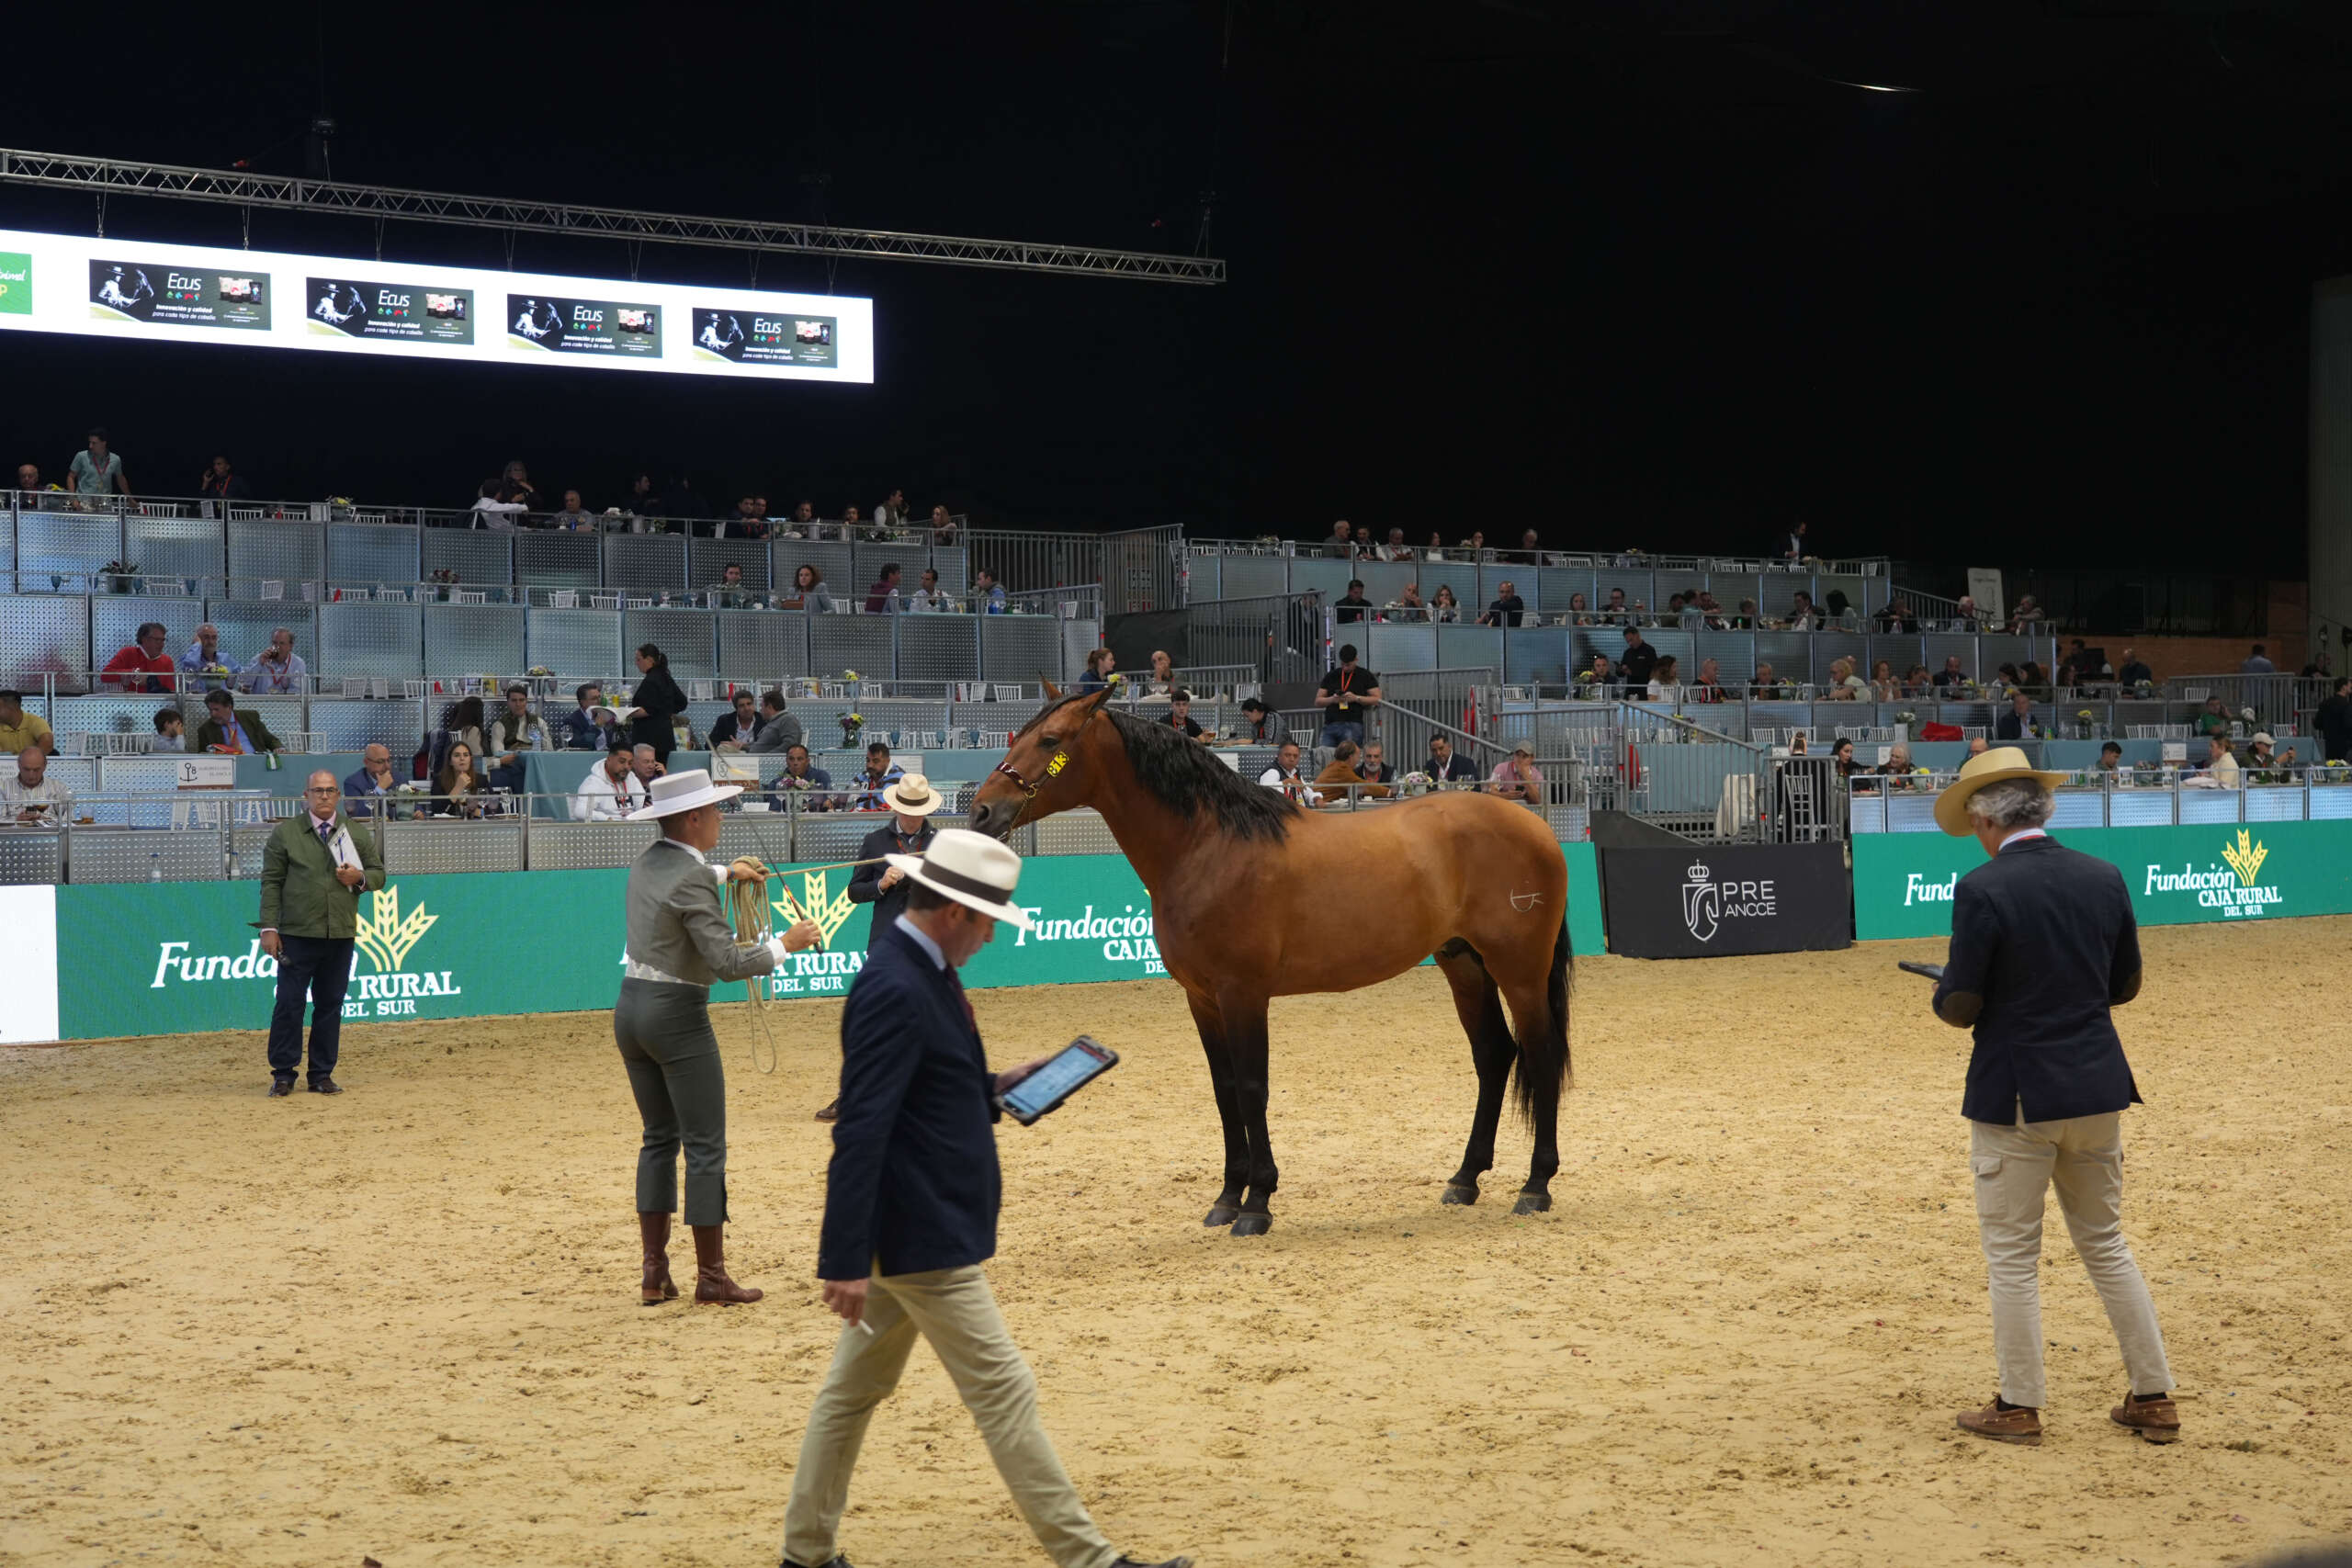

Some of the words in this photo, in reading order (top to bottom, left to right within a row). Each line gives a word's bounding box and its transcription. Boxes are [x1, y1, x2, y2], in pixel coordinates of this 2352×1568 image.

[167, 273, 201, 290] Ecus
[379, 289, 411, 307] Ecus
[573, 305, 603, 322] Ecus
[754, 318, 782, 334] Ecus
[1046, 750, 1069, 777] 813
[2144, 863, 2235, 896] Fundación
[1723, 880, 1776, 901] PRE
[2198, 888, 2233, 908] CAJA
[2234, 886, 2283, 905] RURAL
[1724, 902, 1777, 918] ANCCE
[2223, 906, 2243, 917] DEL
[2245, 905, 2264, 916] SUR
[1103, 938, 1162, 961] CAJA
[1145, 961, 1168, 974] DE
[358, 971, 461, 1000] RURAL
[773, 978, 805, 993] DEL
[809, 976, 844, 991] SUR
[377, 999, 417, 1016] SUR
